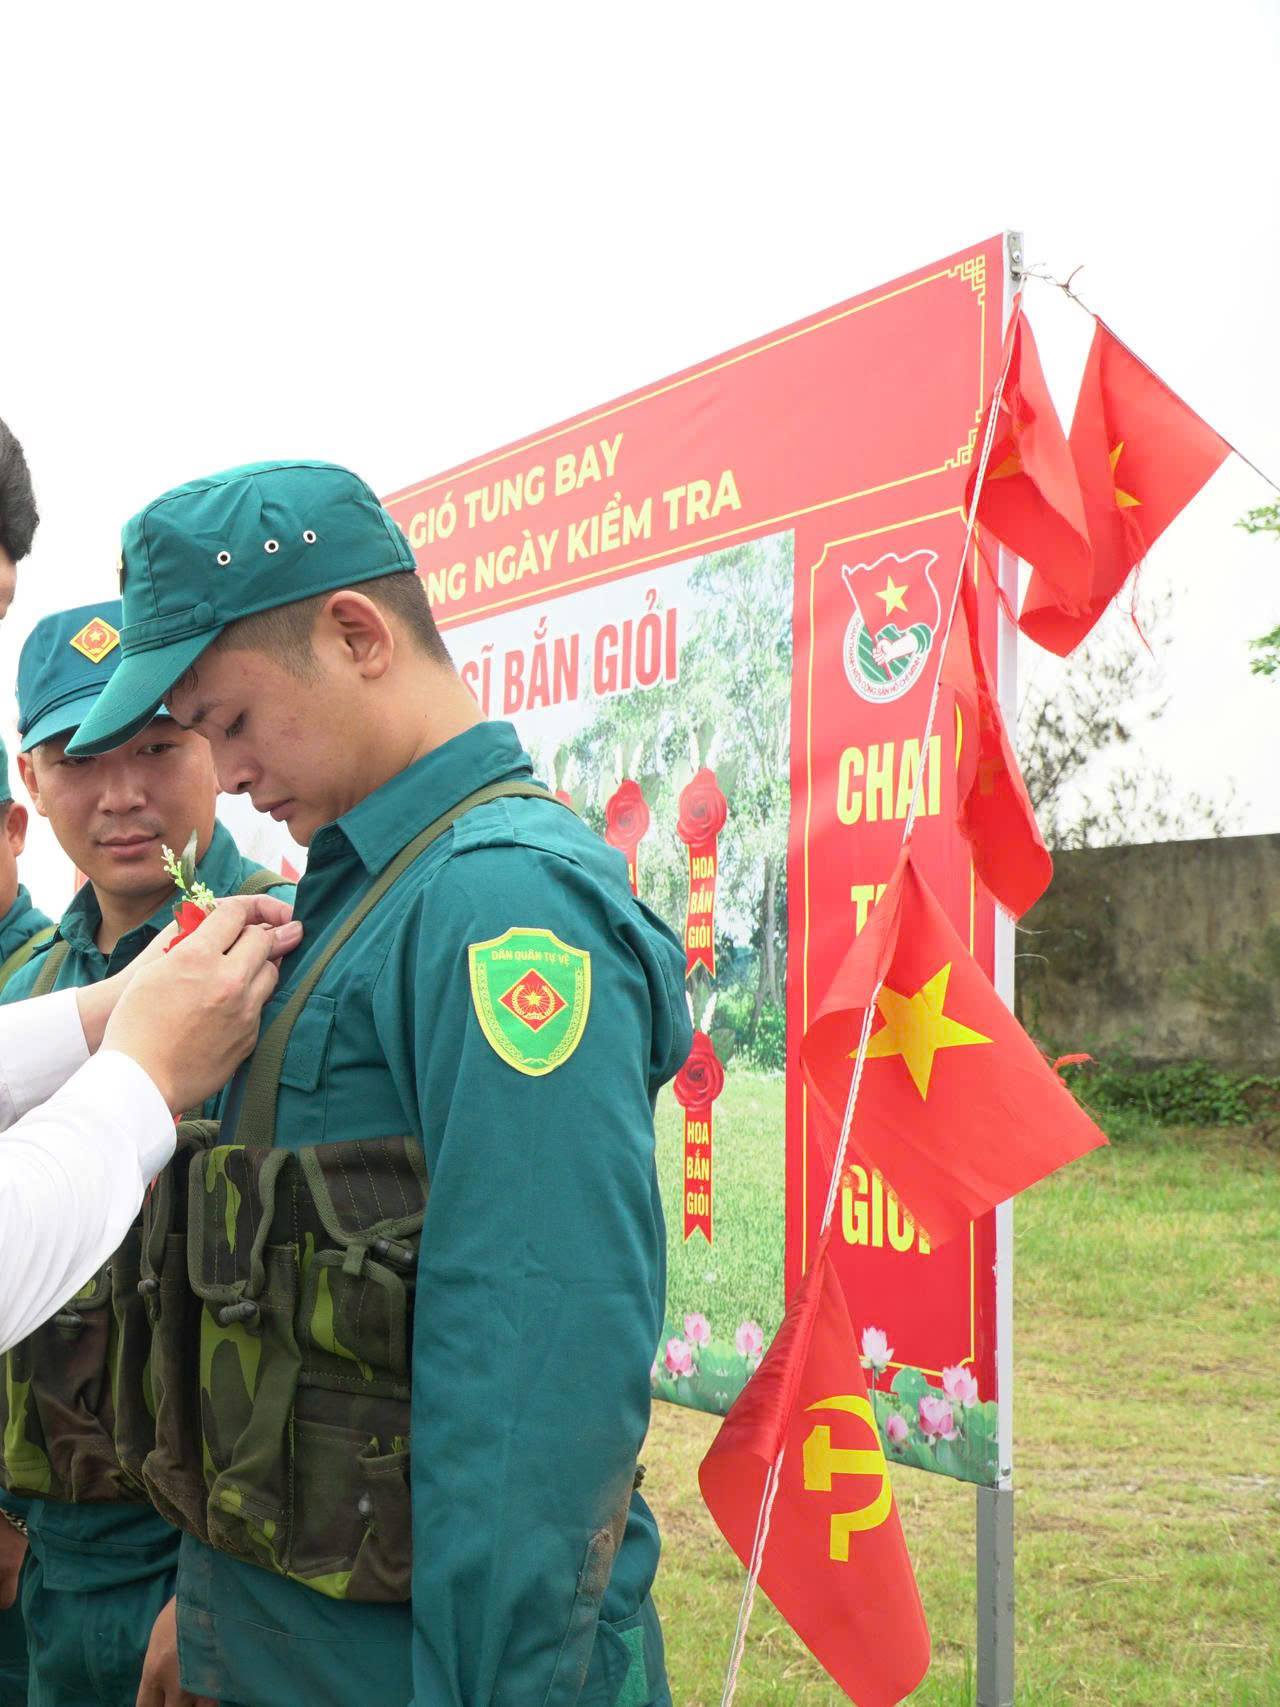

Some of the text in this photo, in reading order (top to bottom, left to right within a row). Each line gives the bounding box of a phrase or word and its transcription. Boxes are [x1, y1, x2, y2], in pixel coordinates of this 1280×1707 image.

[409, 433, 624, 550] GIÓ TUNG BAY
[420, 469, 742, 608] NG NGÀY KIỂM TRA
[504, 616, 579, 715] BẮN
[592, 588, 678, 696] GIỎI
[836, 735, 942, 825] CHAI
[692, 855, 715, 880] HOA
[690, 883, 713, 914] BẮN
[687, 918, 711, 949] GIỎI
[687, 1121, 709, 1145] HOA
[686, 1148, 710, 1182] BẮN
[686, 1185, 709, 1216] GIỎI
